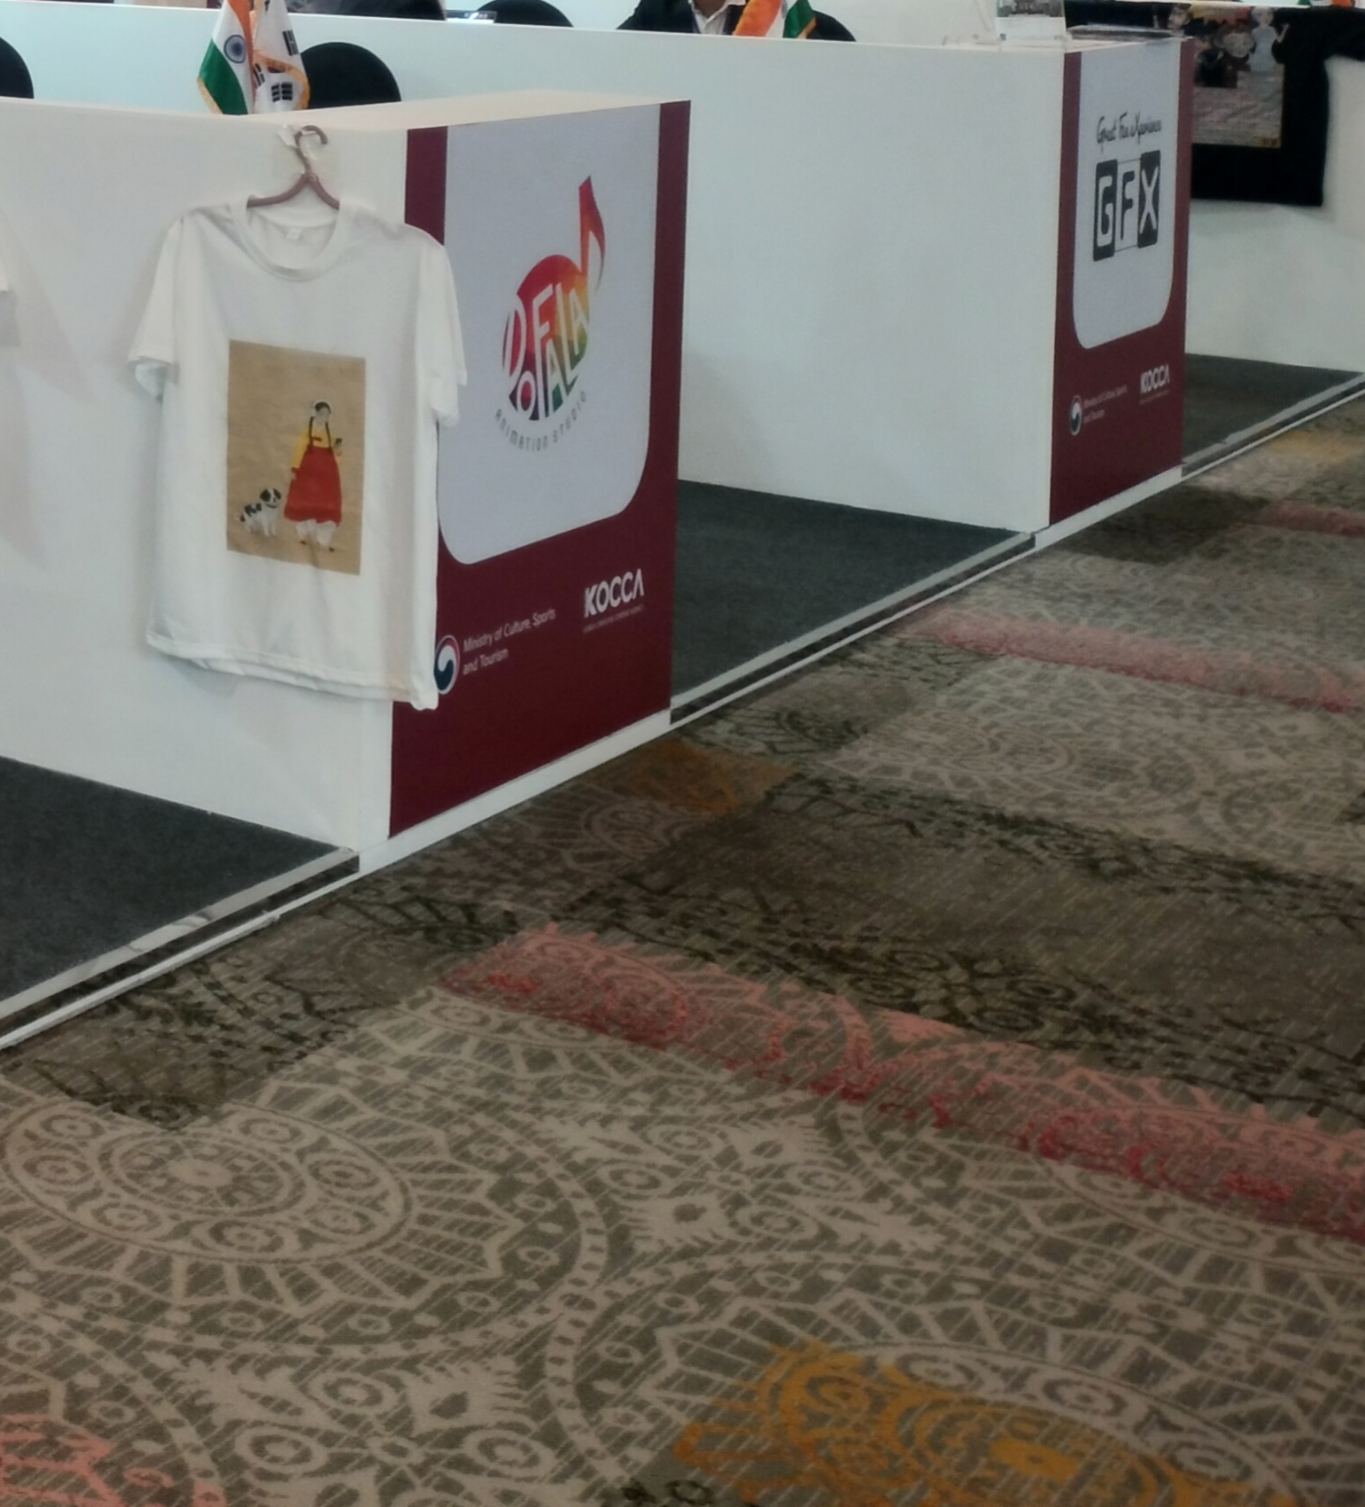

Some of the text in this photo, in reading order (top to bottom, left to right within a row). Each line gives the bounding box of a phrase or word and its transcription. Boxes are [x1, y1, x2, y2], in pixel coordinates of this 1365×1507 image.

[1096, 165, 1160, 249] GFX
[583, 568, 645, 619] KOCCA
[532, 607, 556, 627] Sports
[462, 647, 509, 675] and Tourism
